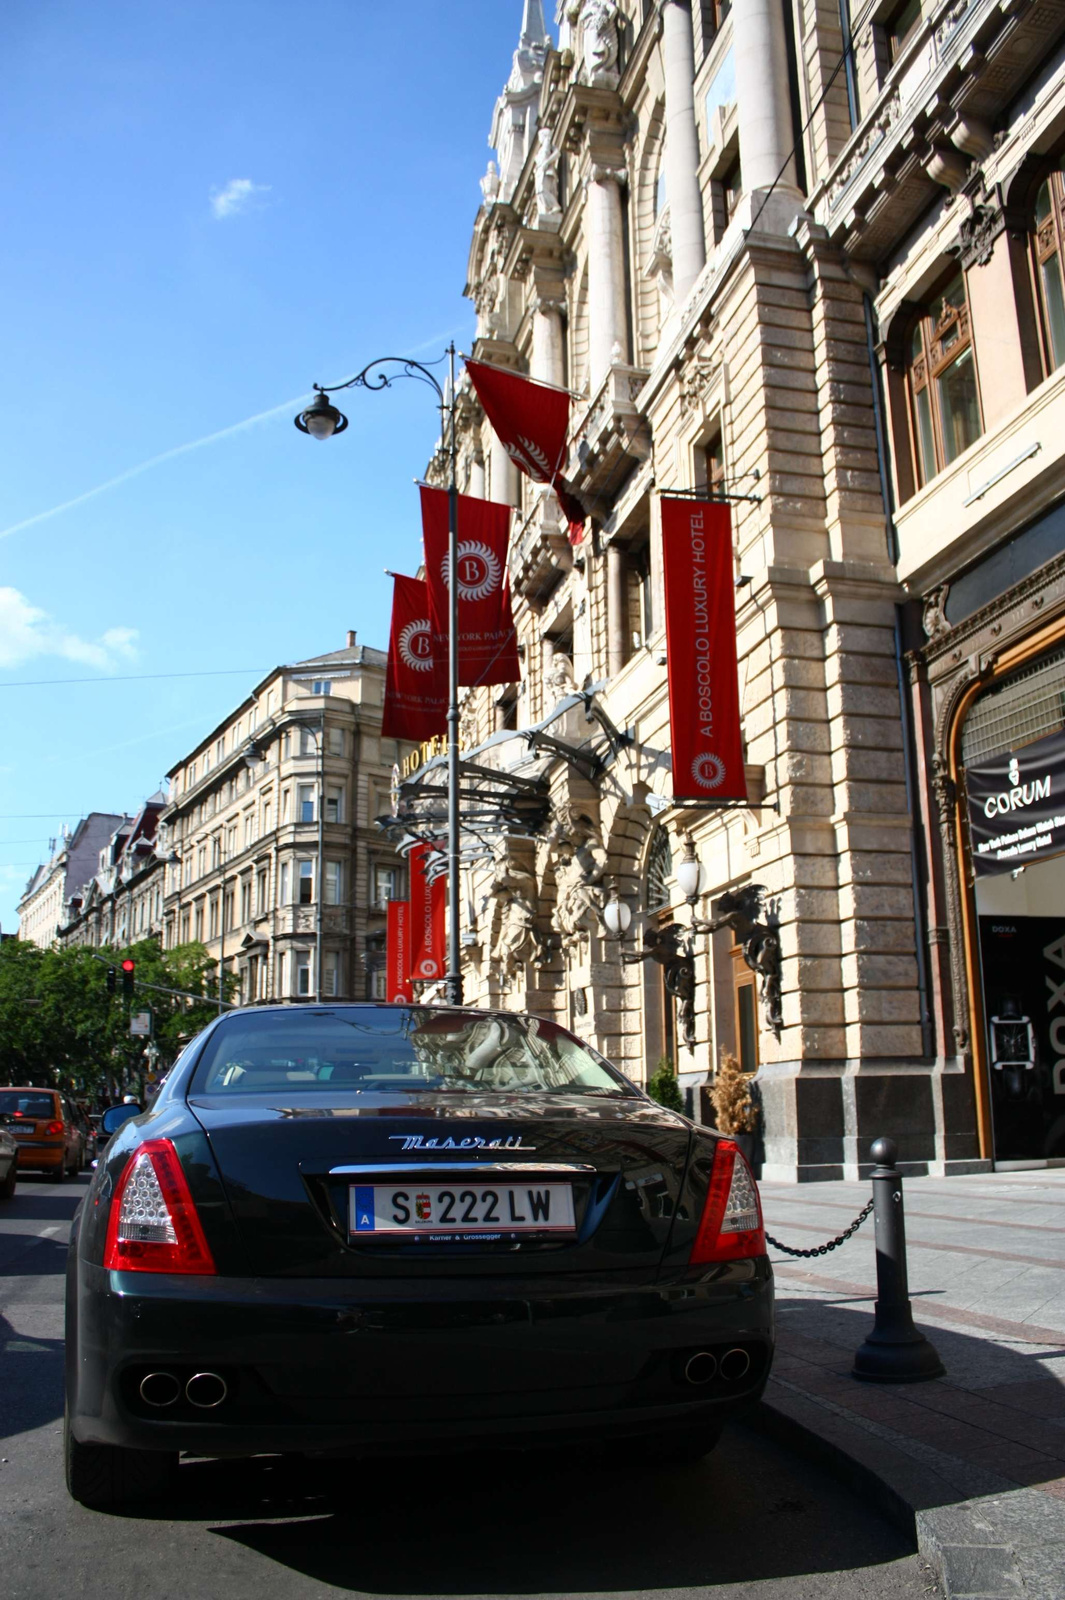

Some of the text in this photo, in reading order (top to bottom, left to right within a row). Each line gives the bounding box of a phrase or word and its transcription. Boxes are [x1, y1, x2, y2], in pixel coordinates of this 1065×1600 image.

[690, 510, 713, 737] A BOSCOLO LUXURY HOTEL
[984, 775, 1051, 819] CORUM
[992, 925, 1017, 934] DOXA
[388, 1135, 536, 1150] Maserati
[361, 1214, 370, 1225] A
[391, 1191, 411, 1225] S
